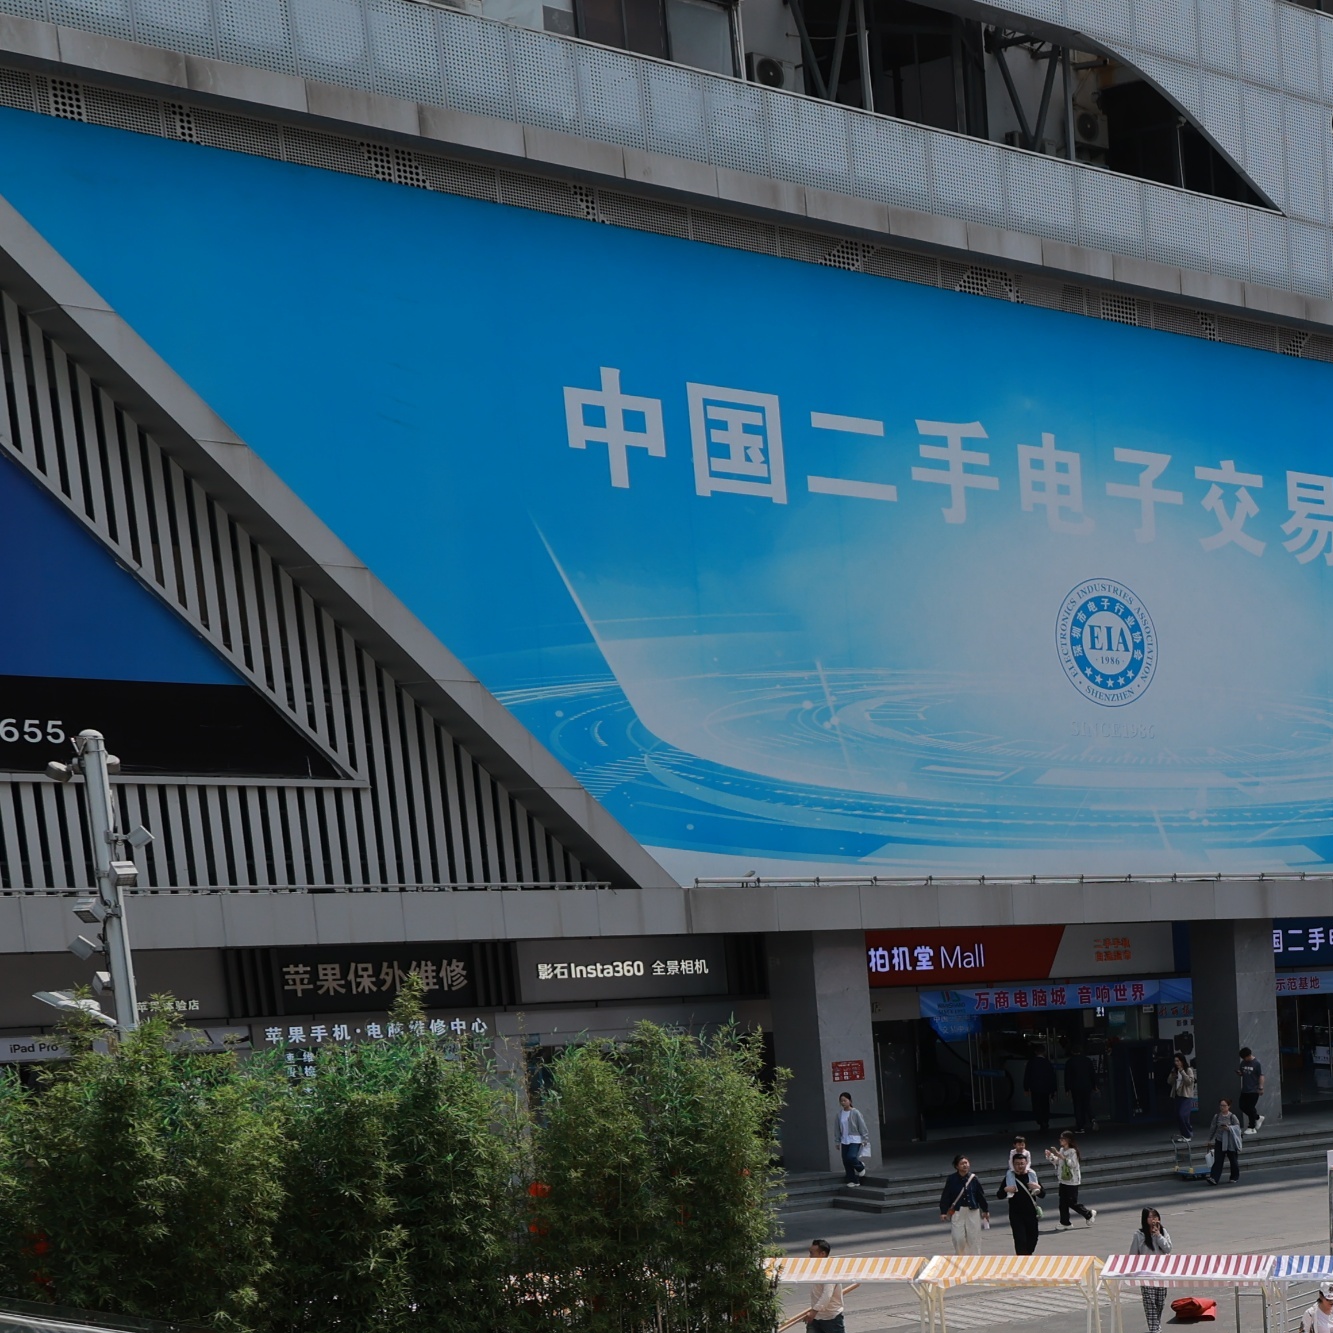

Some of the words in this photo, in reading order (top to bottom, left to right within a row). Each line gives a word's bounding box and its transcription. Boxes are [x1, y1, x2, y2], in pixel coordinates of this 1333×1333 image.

[1076, 582, 1134, 606] INDUSTRIES
[1059, 598, 1079, 679] ELECTRONICS
[1071, 598, 1144, 661] 深圳市电子行业协会
[1087, 624, 1131, 653] EIA
[1134, 606, 1155, 683] ASSOCIATION
[1101, 656, 1120, 666] 1986
[1085, 684, 1135, 702] SHENZHEN
[0, 718, 66, 744] 655
[537, 960, 645, 980] 影石Insta360
[651, 958, 709, 976] 全景相机
[868, 945, 935, 973] 拍机堂
[940, 943, 986, 970] Mall
[282, 957, 468, 997] 苹果保外维修
[1275, 975, 1320, 992] 示范基地
[974, 986, 1067, 1011] 万商电脑城
[1077, 983, 1146, 1005] 音响世界
[9, 1043, 35, 1054] iPad
[38, 1042, 59, 1053] Pro
